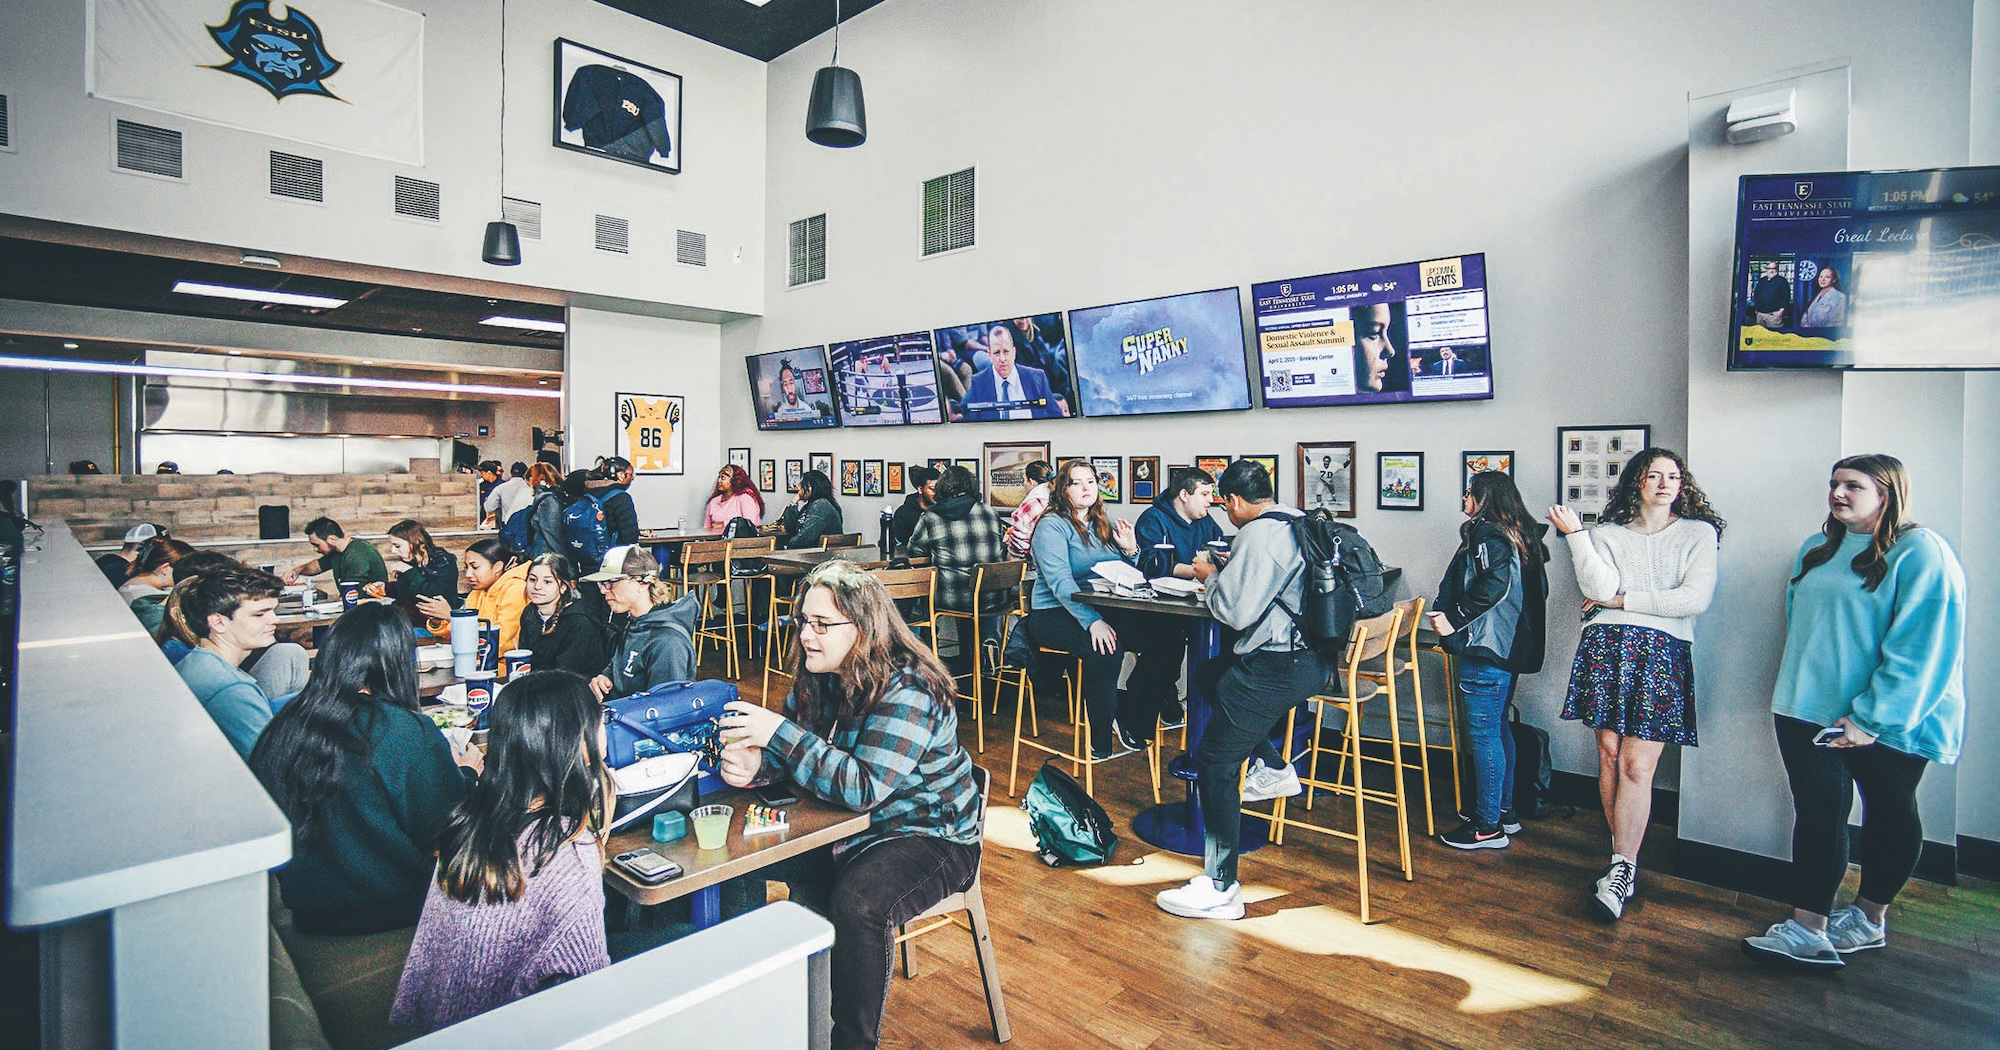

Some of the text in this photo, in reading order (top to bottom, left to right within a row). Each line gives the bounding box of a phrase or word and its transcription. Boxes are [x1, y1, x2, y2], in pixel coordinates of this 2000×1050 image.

[249, 17, 308, 40] ETSU
[1883, 190, 1930, 202] 1:05 PM
[1752, 201, 1853, 211] EAST TENNESSEE STATE
[1834, 228, 1872, 244] Great
[1425, 265, 1456, 277] UPCOMING
[1427, 273, 1457, 288] EVENTS
[1331, 283, 1358, 294] 1:05 PM
[1259, 294, 1315, 307] EAST TENNESSEE STATE
[1269, 301, 1306, 310] UNIVERSITY
[1266, 332, 1297, 342] Domestic
[1299, 329, 1329, 339] Violence
[1267, 335, 1345, 349] Sexual Assault Summit
[1122, 326, 1173, 365] SUPER
[1138, 336, 1188, 375] NANNY
[1149, 392, 1173, 400] streaming
[640, 427, 661, 448] 86
[1319, 470, 1334, 479] 70
